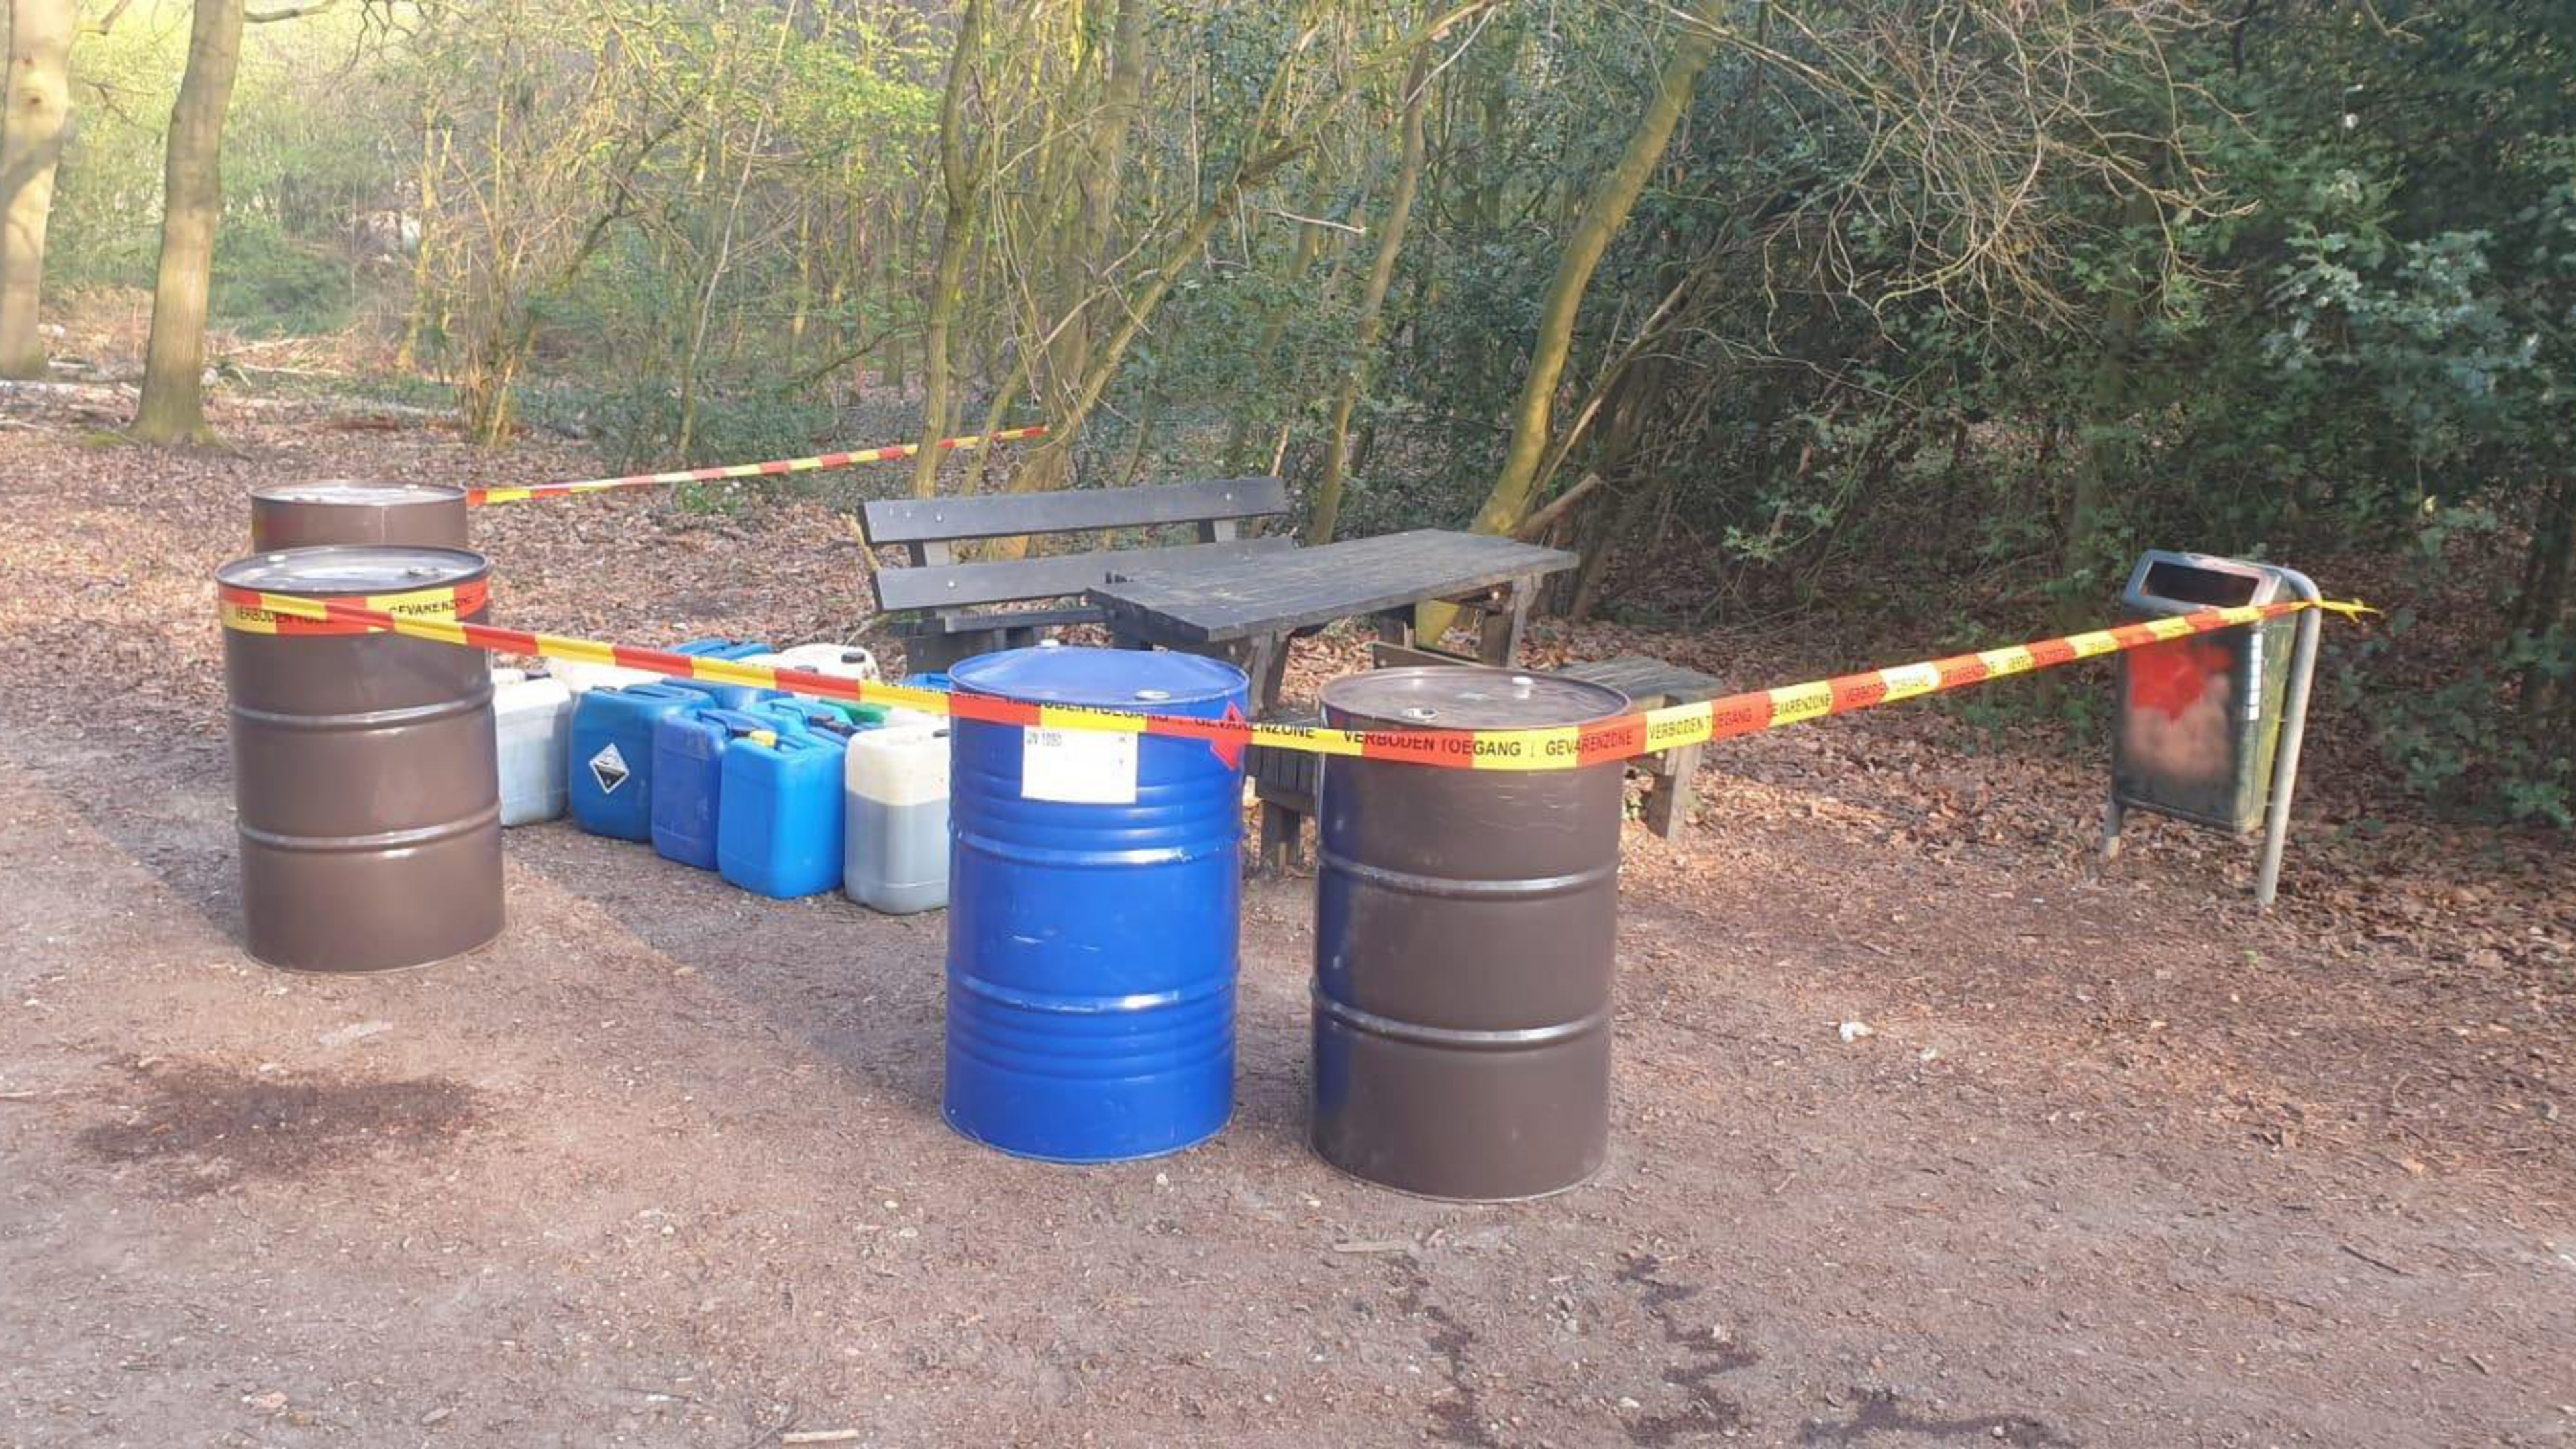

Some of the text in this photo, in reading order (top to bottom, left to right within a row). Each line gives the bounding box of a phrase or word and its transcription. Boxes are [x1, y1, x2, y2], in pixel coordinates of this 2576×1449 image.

[1344, 730, 1435, 751] VERBODEN
[1443, 739, 1521, 757] TOEGANG
[1545, 731, 1633, 756] GEVARENZONE
[1649, 716, 1703, 739] VERBODEN
